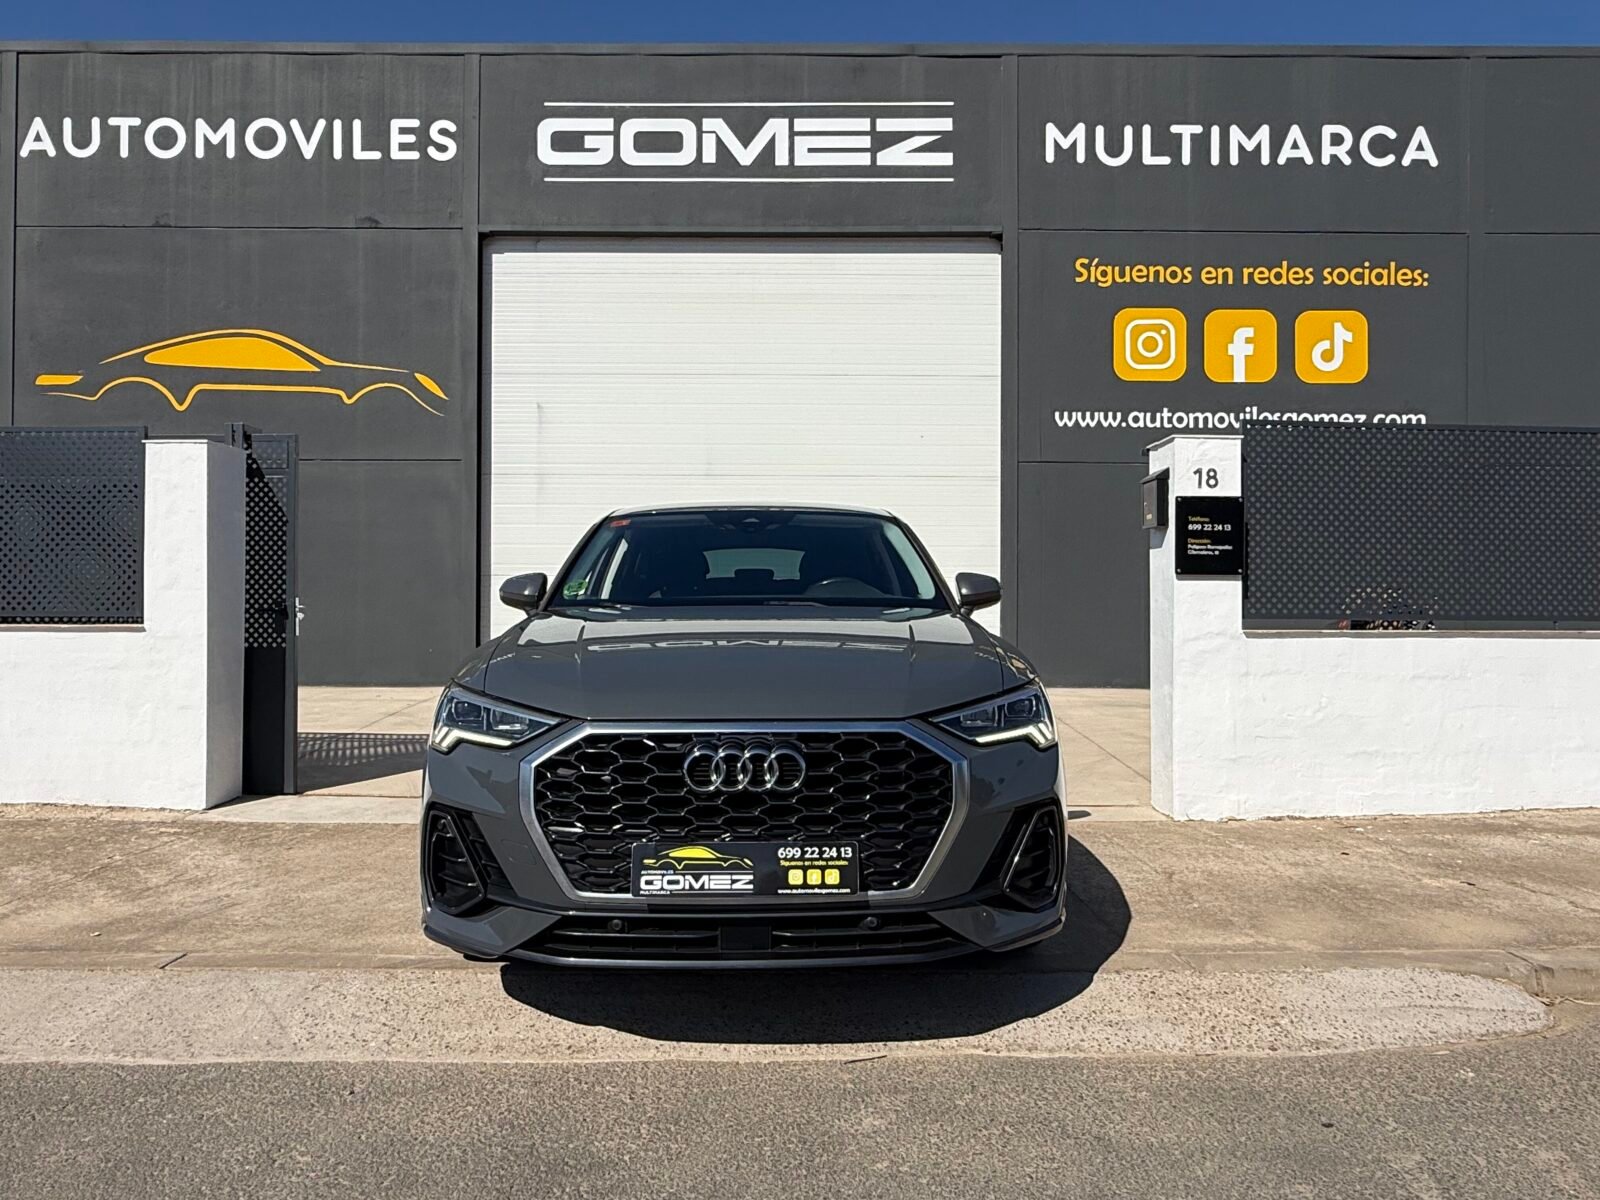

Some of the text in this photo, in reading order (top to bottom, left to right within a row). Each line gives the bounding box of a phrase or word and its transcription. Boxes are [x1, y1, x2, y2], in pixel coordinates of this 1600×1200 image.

[19, 116, 458, 162] AUTOMOVILES
[536, 117, 954, 167] GOMEZ
[1045, 122, 1439, 168] MULTIMARCA
[1074, 257, 1430, 288] Síguenos en redes sociales:
[1054, 405, 1427, 428] www.automovilomezcom
[1193, 467, 1219, 489] 18
[1188, 523, 1202, 531] 699
[1203, 523, 1213, 531] 22
[1213, 523, 1223, 531] 24
[777, 846, 853, 859] 699 22 24 13
[639, 874, 754, 890] GOMEZ
